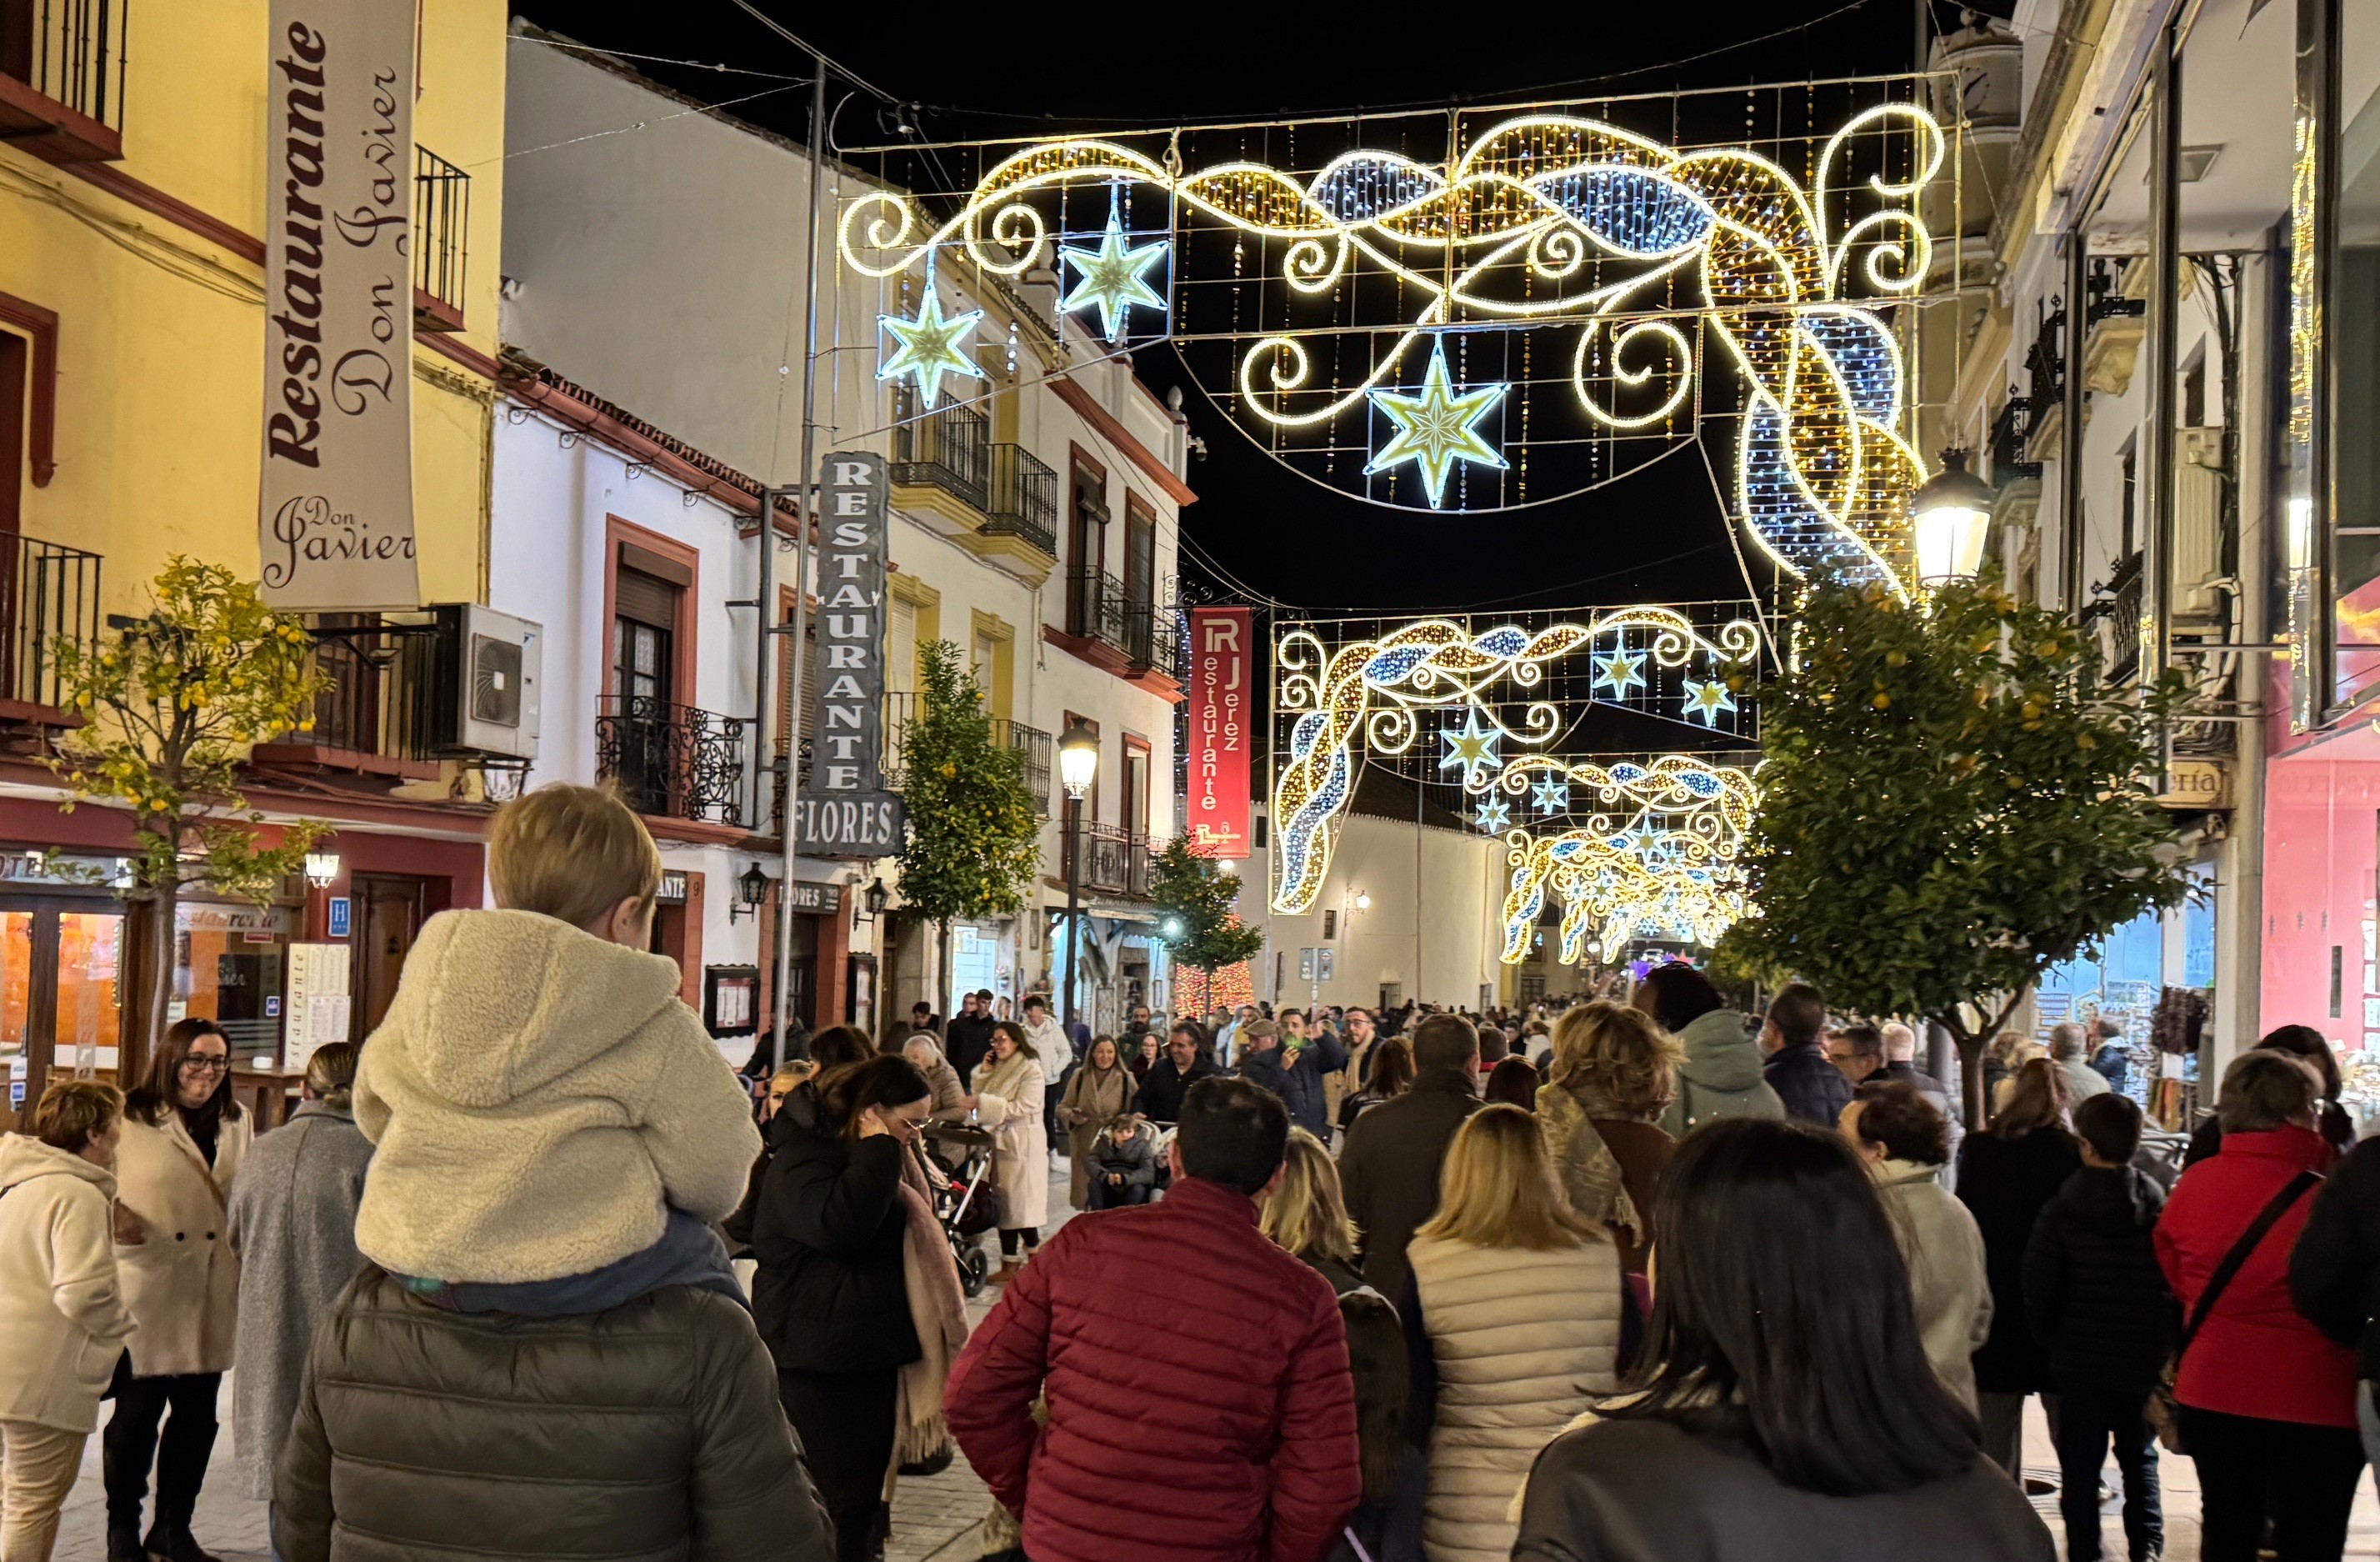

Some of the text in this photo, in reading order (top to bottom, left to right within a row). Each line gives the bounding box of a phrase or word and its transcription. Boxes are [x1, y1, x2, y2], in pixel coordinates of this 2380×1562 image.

[269, 21, 326, 468] Restaurante
[332, 67, 408, 416] Don Javier
[263, 495, 416, 589] Javier
[305, 495, 355, 525] Don
[822, 460, 872, 791] RESTAURANTE
[1223, 656, 1240, 752] Jerez
[334, 904, 346, 922] H
[693, 881, 700, 897] 9
[778, 884, 820, 907] ORES
